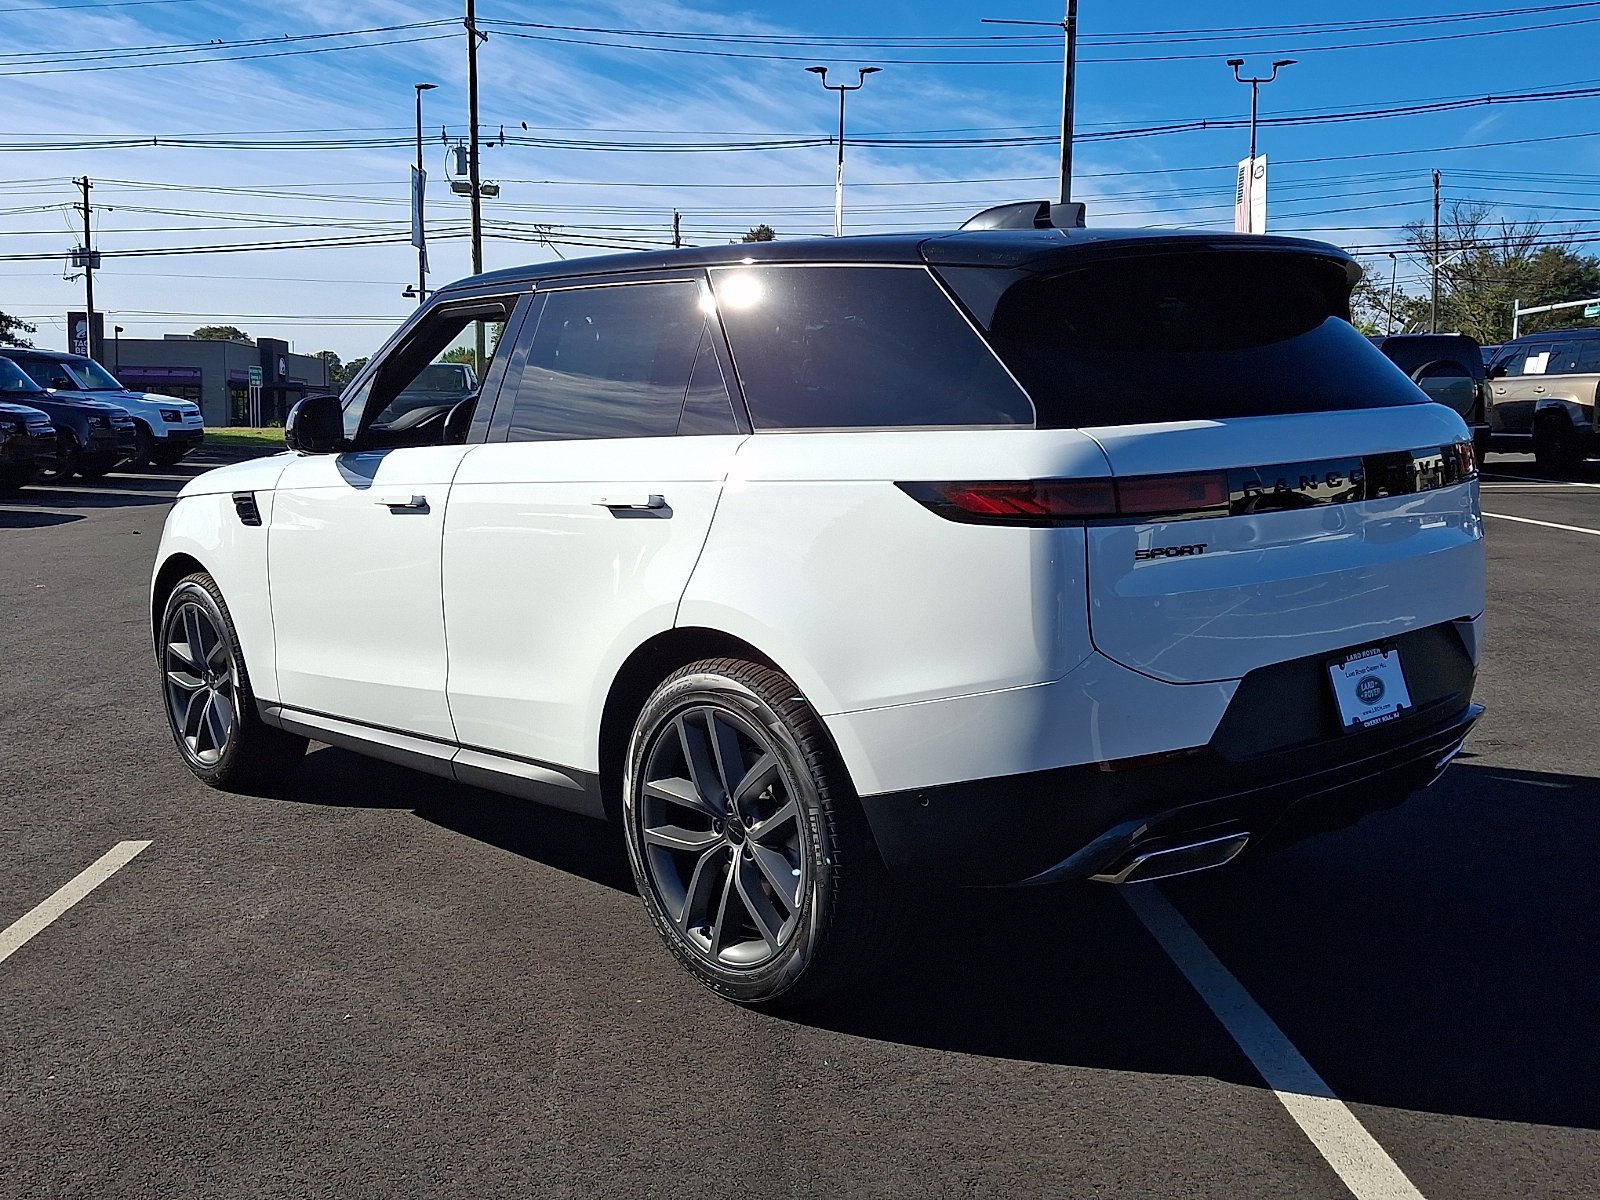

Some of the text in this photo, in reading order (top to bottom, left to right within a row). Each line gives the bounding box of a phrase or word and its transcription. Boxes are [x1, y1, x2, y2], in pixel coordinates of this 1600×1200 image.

[1242, 469, 1363, 498] RANGE
[1135, 543, 1208, 560] SPORT
[1346, 649, 1381, 661] LAND ROVER
[1361, 681, 1375, 691] LAND
[1364, 687, 1381, 699] ROVER
[1364, 719, 1381, 727] CHERRY
